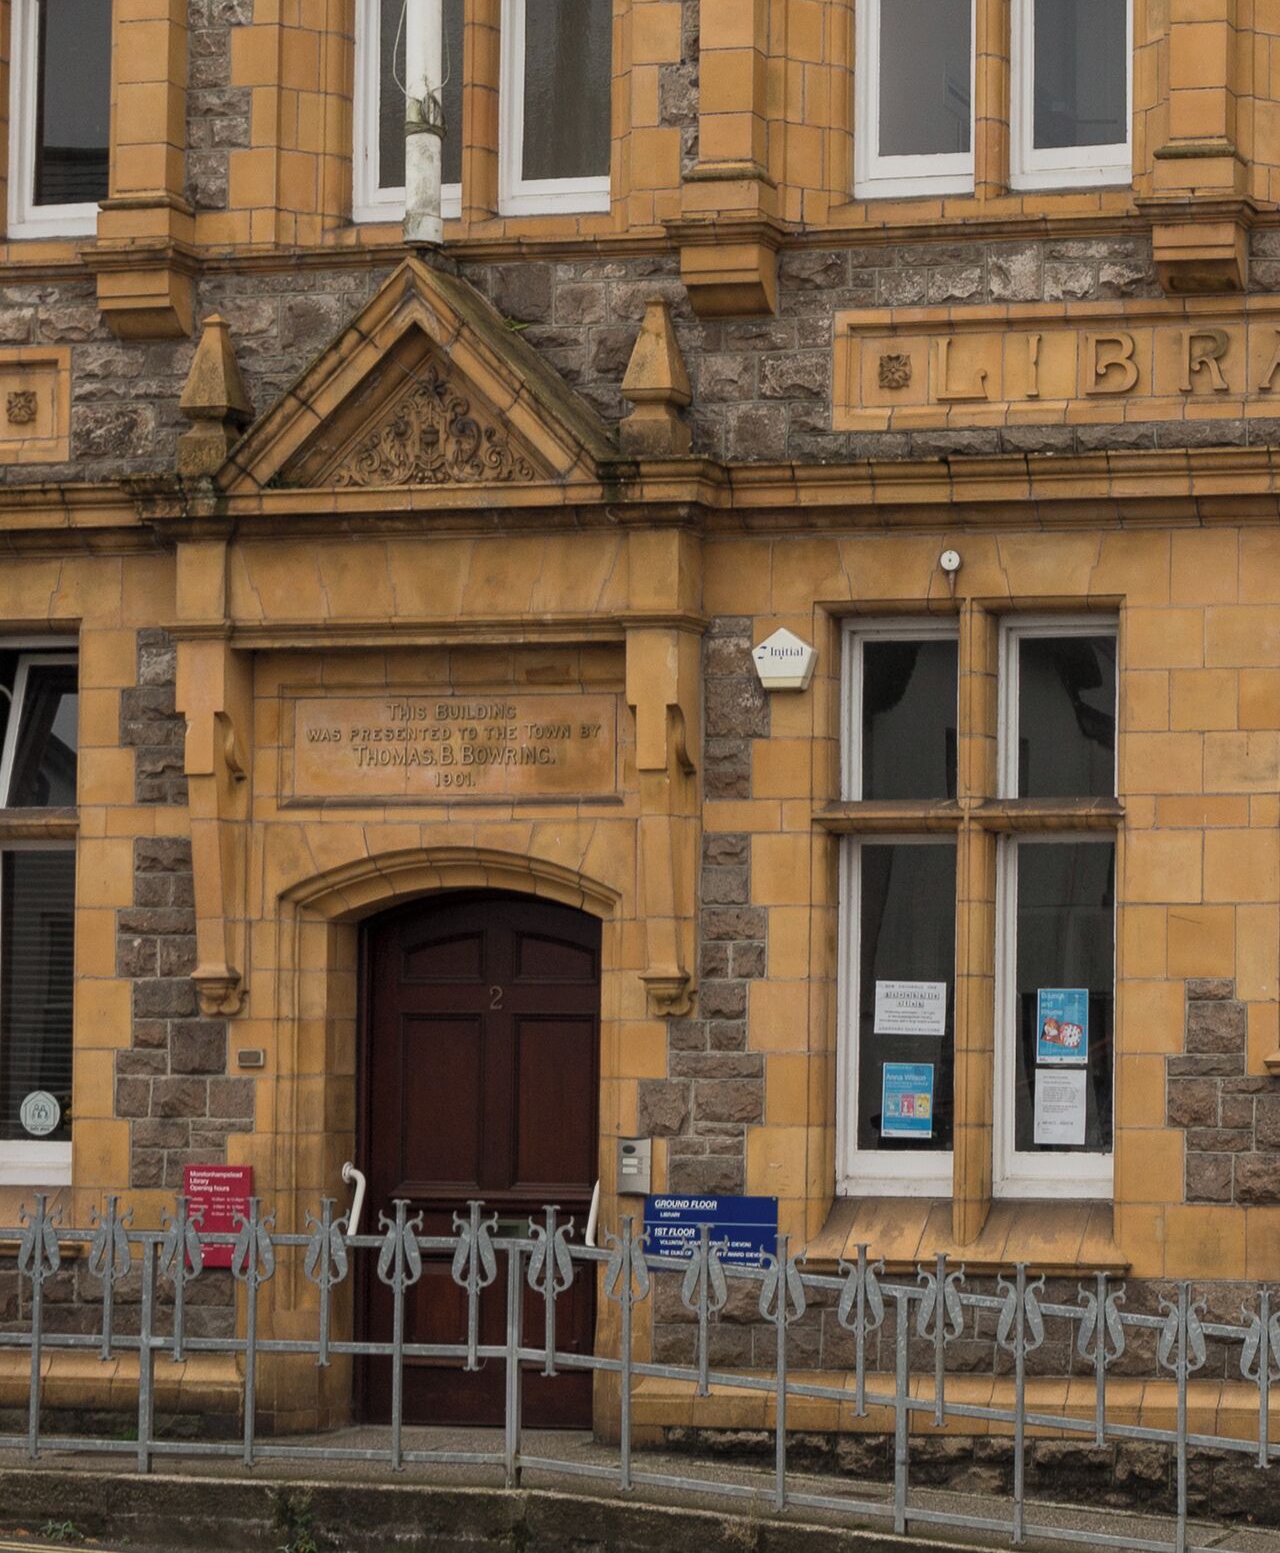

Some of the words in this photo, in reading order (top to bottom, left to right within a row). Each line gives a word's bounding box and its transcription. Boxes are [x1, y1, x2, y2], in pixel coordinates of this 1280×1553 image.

[770, 646, 804, 657] Initial
[385, 702, 427, 721] THIS
[435, 701, 517, 720] BUILDING
[307, 727, 342, 743] WAS
[350, 726, 452, 743] PRESENTED
[458, 726, 478, 741] TO
[484, 726, 518, 741] THE
[580, 723, 602, 739] BY
[489, 985, 503, 1010] 2
[655, 1199, 689, 1209] GROUND
[690, 1200, 718, 1209] FLOOR
[654, 1227, 667, 1236] 1ST
[667, 1228, 696, 1237] FLOOR
